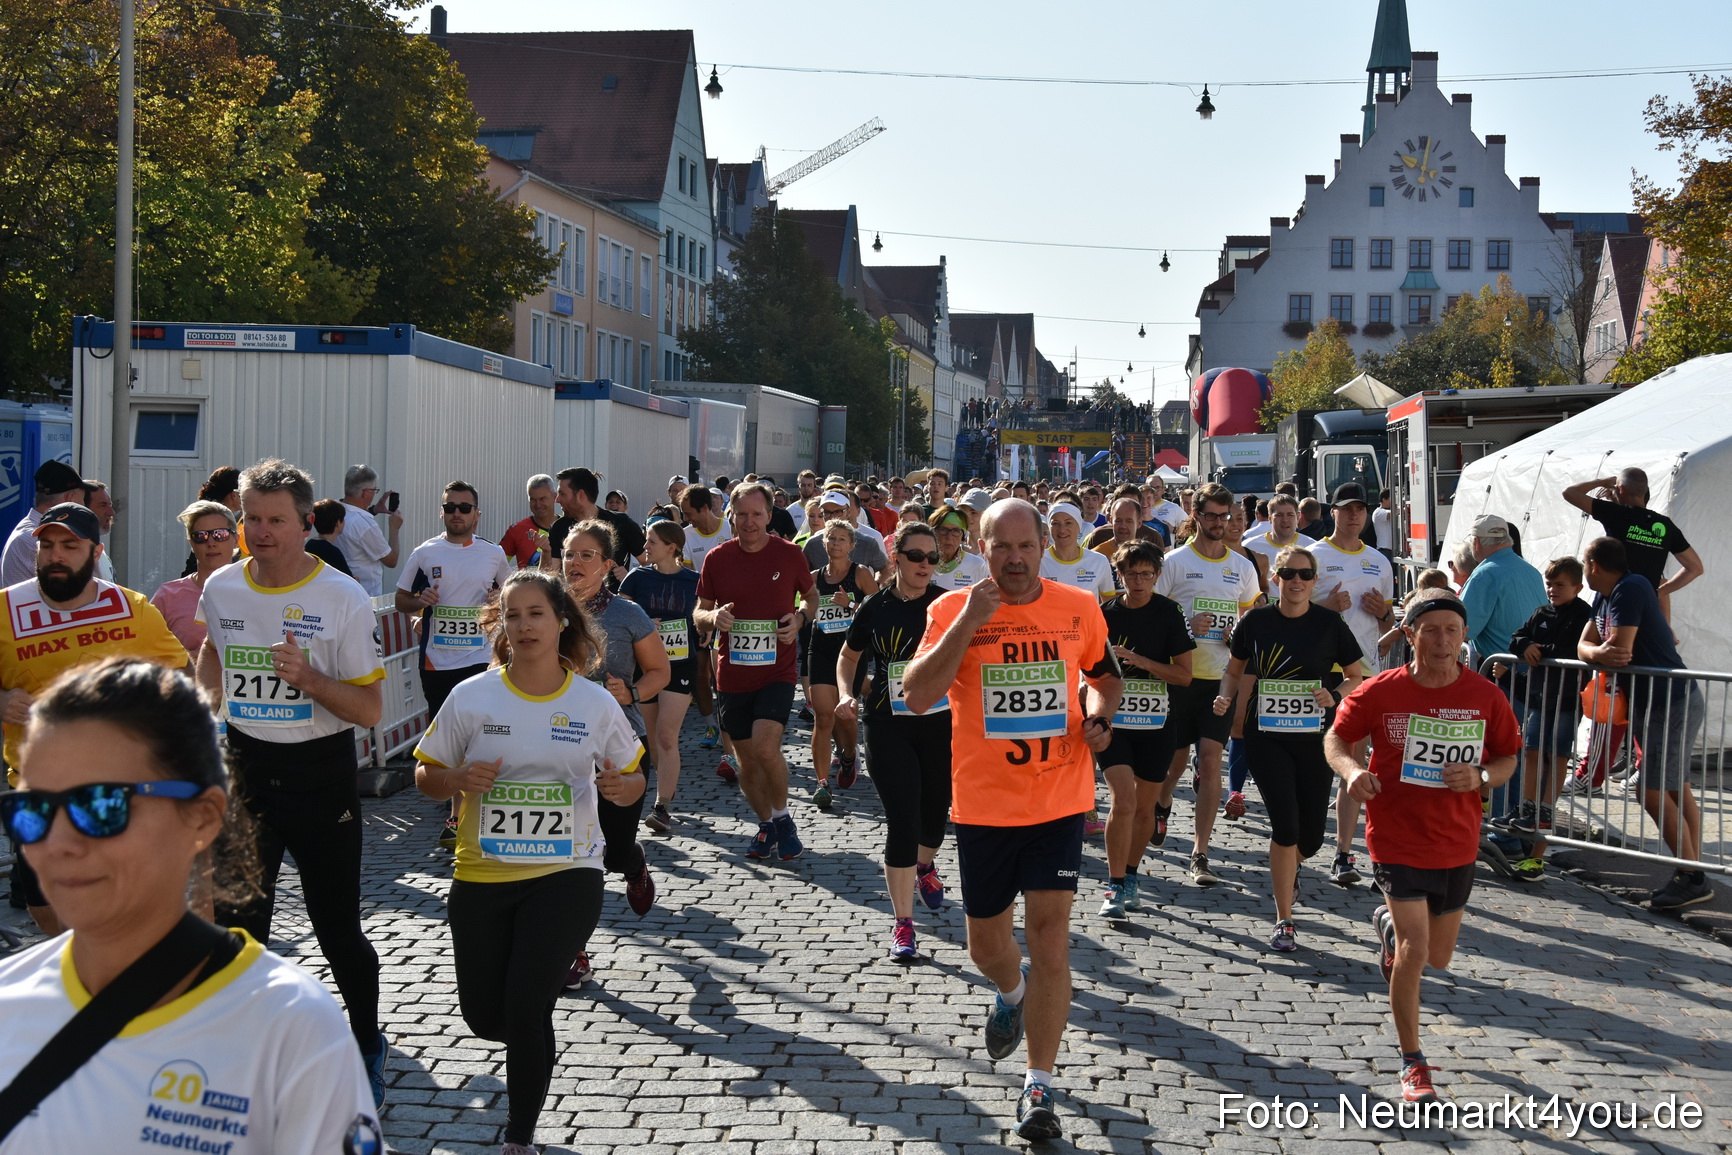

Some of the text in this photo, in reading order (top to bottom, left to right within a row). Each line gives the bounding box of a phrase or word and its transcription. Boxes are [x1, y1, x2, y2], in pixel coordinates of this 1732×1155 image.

[1036, 434, 1075, 444] START
[1627, 525, 1652, 536] physio
[1626, 532, 1663, 545] neumarkt
[436, 606, 478, 617] BOCK
[1198, 600, 1235, 611] BOCK
[284, 607, 303, 620] 20
[820, 607, 851, 621] 2645
[283, 620, 325, 632] Neumarkter
[438, 620, 477, 635] 2333
[733, 622, 772, 632] BOCK
[281, 629, 314, 640] Sdtlauf
[16, 626, 136, 662] MAX BÖGL
[733, 635, 770, 650] 2271
[231, 650, 274, 666] BO
[1002, 640, 1060, 664] RUN
[989, 665, 1059, 684] BOCK
[233, 673, 301, 700] 2173
[1264, 681, 1315, 693] BOCK
[992, 688, 1058, 713] 2832
[1118, 697, 1161, 713] 2592
[1265, 698, 1314, 714] 2595
[240, 705, 295, 719] ROLAND
[1439, 708, 1481, 716] NEUMARKTER
[552, 715, 569, 727] 20
[1123, 716, 1152, 724] MARIA
[483, 724, 511, 733] BOCK
[551, 727, 590, 737] Neumarkter
[1416, 720, 1478, 739] BOCK
[551, 734, 582, 744] Stadtlauf
[1413, 741, 1475, 764] 2500
[1413, 767, 1443, 780] NOR
[490, 786, 564, 803] BOCK
[490, 809, 563, 835] 2172
[496, 842, 556, 854] TAMARA
[1057, 870, 1079, 878] CRAFT
[153, 1069, 247, 1111] 20 JAHRE
[146, 1103, 248, 1137] Neumarkte
[141, 1126, 233, 1155] Stadtlauf
